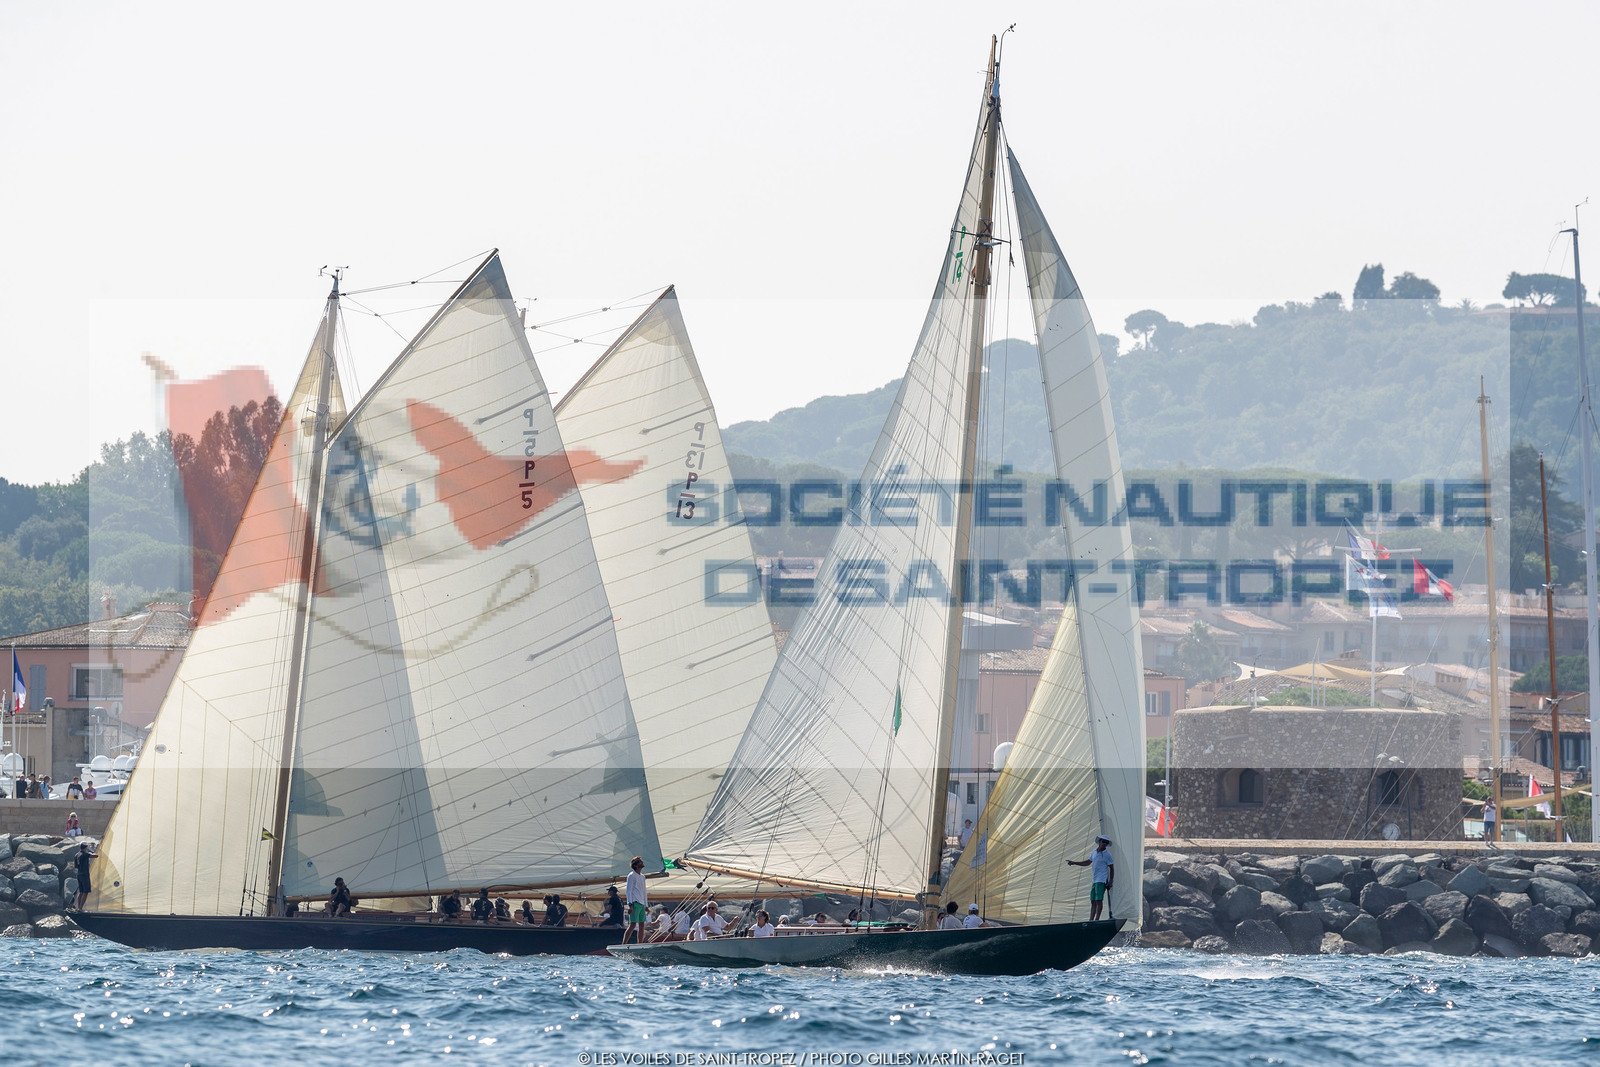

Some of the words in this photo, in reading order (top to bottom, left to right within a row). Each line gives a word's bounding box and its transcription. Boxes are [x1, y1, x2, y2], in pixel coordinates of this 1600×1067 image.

[524, 460, 536, 479] P
[685, 471, 699, 490] P
[521, 490, 533, 509] 5
[675, 499, 696, 520] 13
